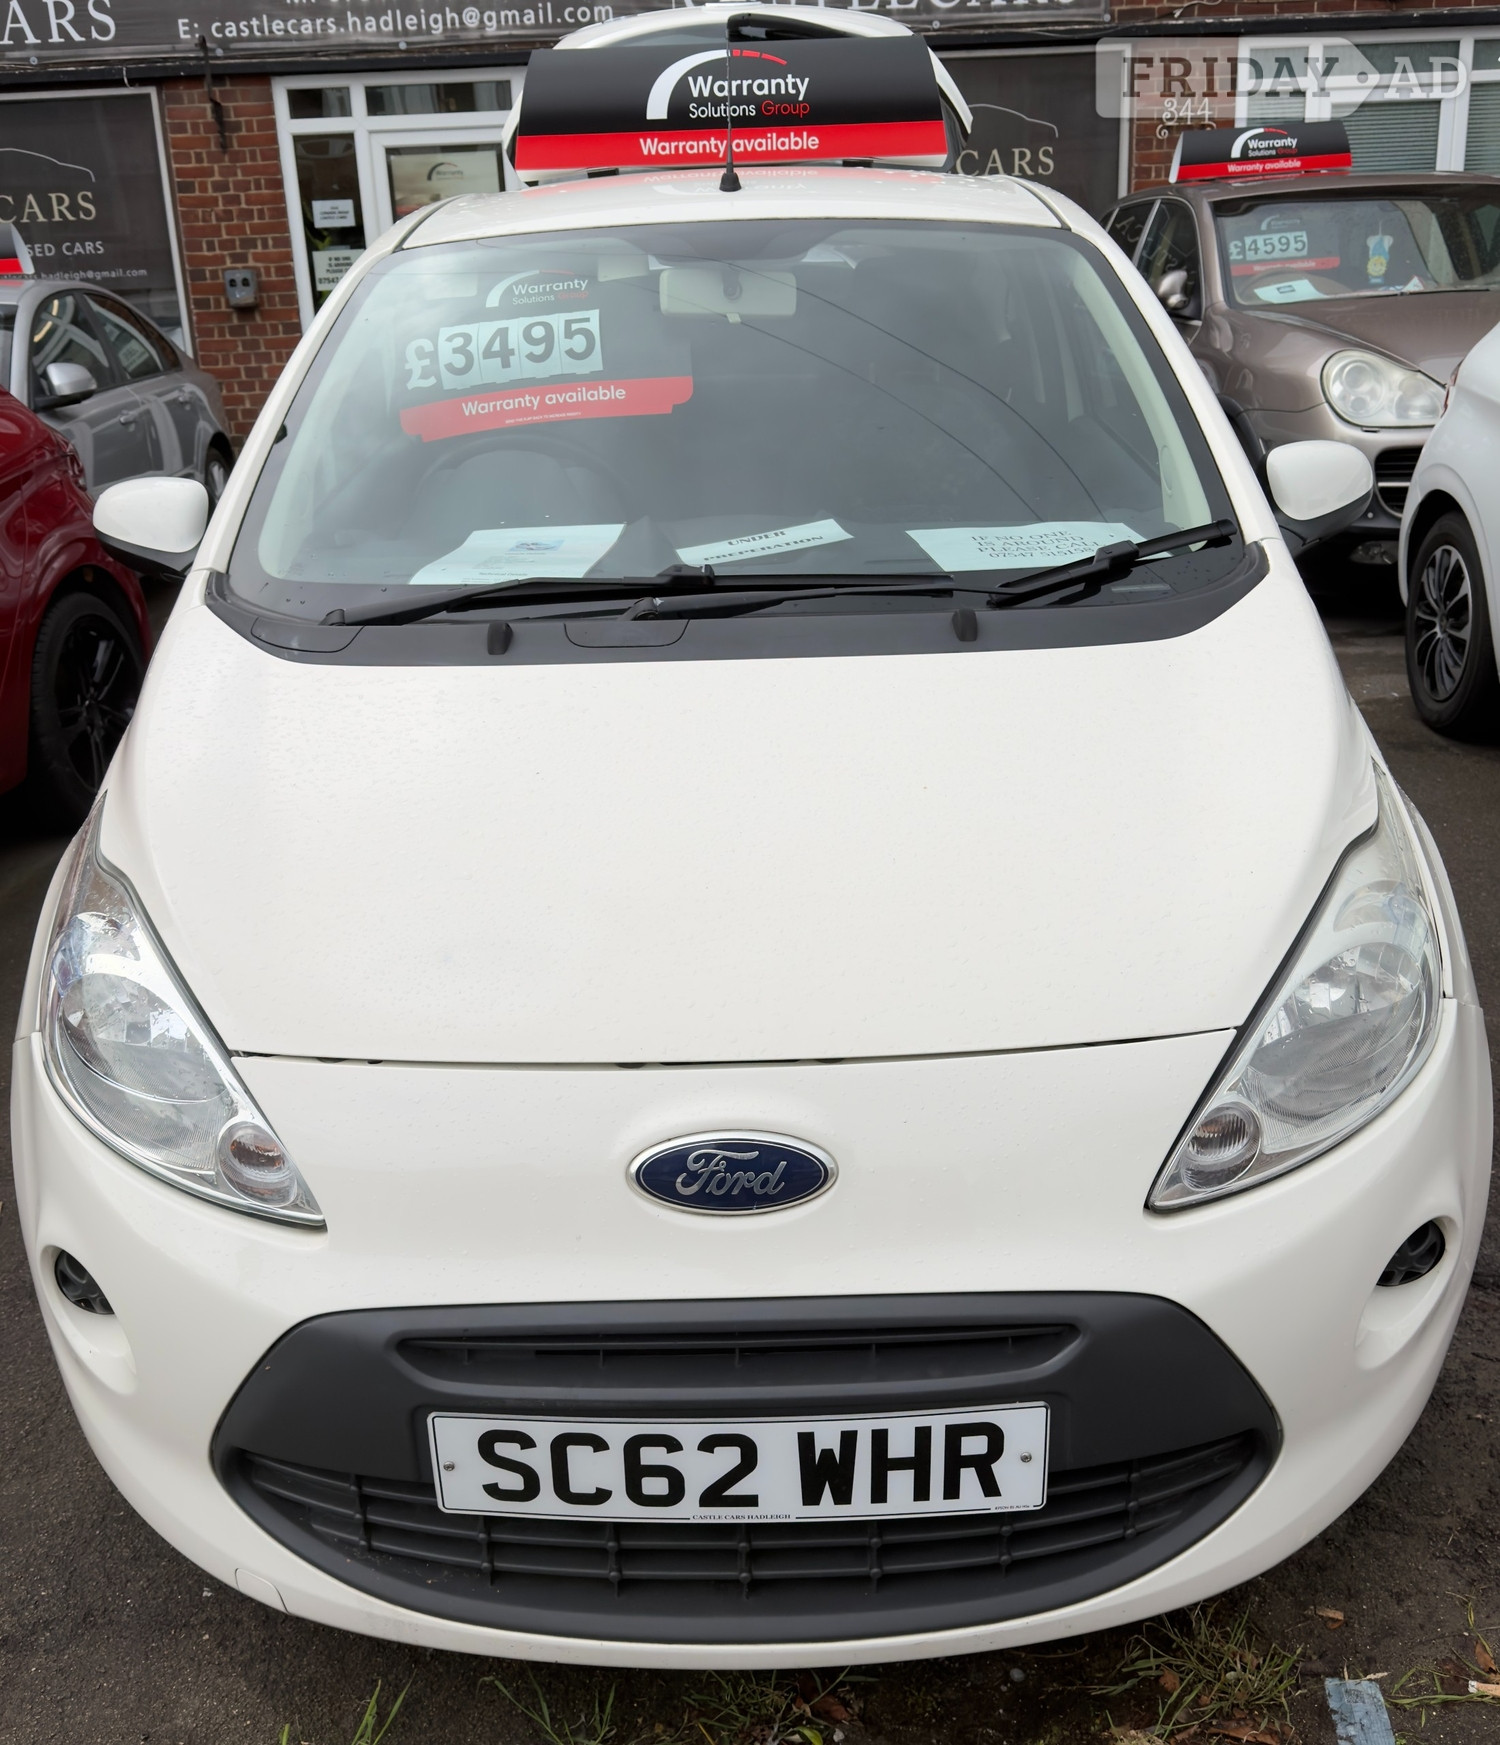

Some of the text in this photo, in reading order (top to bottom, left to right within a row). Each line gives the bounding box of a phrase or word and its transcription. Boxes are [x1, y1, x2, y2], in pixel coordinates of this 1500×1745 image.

[177, 2, 614, 39] E: castlecars.hadleigh@gmail.com
[687, 74, 809, 101] Warranty
[688, 100, 810, 119] Solutions Group
[1161, 98, 1214, 125] 344
[639, 131, 819, 158] Warranty available
[1247, 136, 1298, 149] Warranty
[1248, 148, 1276, 158] Solutions
[955, 146, 1055, 176] CARS
[1227, 159, 1302, 173] Warranty available
[0, 191, 97, 223] CARS
[62, 241, 105, 255] CARS
[1229, 234, 1307, 260] £4595
[511, 278, 589, 297] Warranty
[511, 293, 556, 306] Solutions
[404, 316, 597, 391] £3495
[461, 385, 627, 417] Warranty available
[727, 530, 787, 546] UNDER
[675, 1149, 788, 1197] Ford
[476, 1421, 1005, 1509] SC62 WHR
